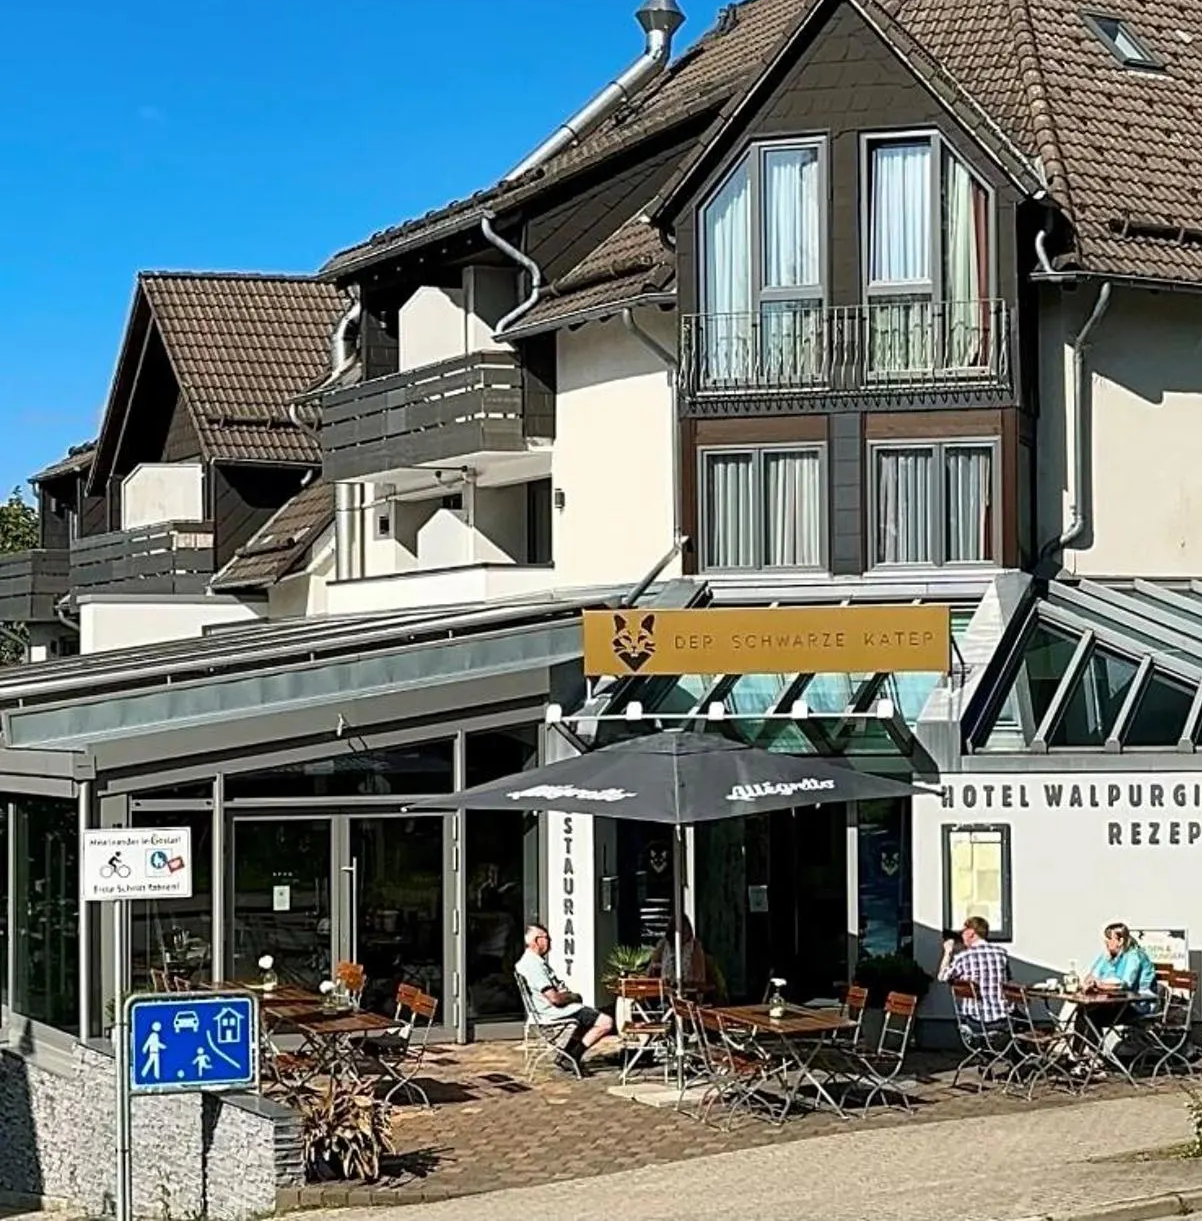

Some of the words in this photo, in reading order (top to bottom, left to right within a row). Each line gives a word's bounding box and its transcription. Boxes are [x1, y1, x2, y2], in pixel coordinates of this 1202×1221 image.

[731, 632, 845, 649] SCHWARZE
[941, 784, 1030, 809] HOTEL
[562, 816, 576, 977] STAURANT
